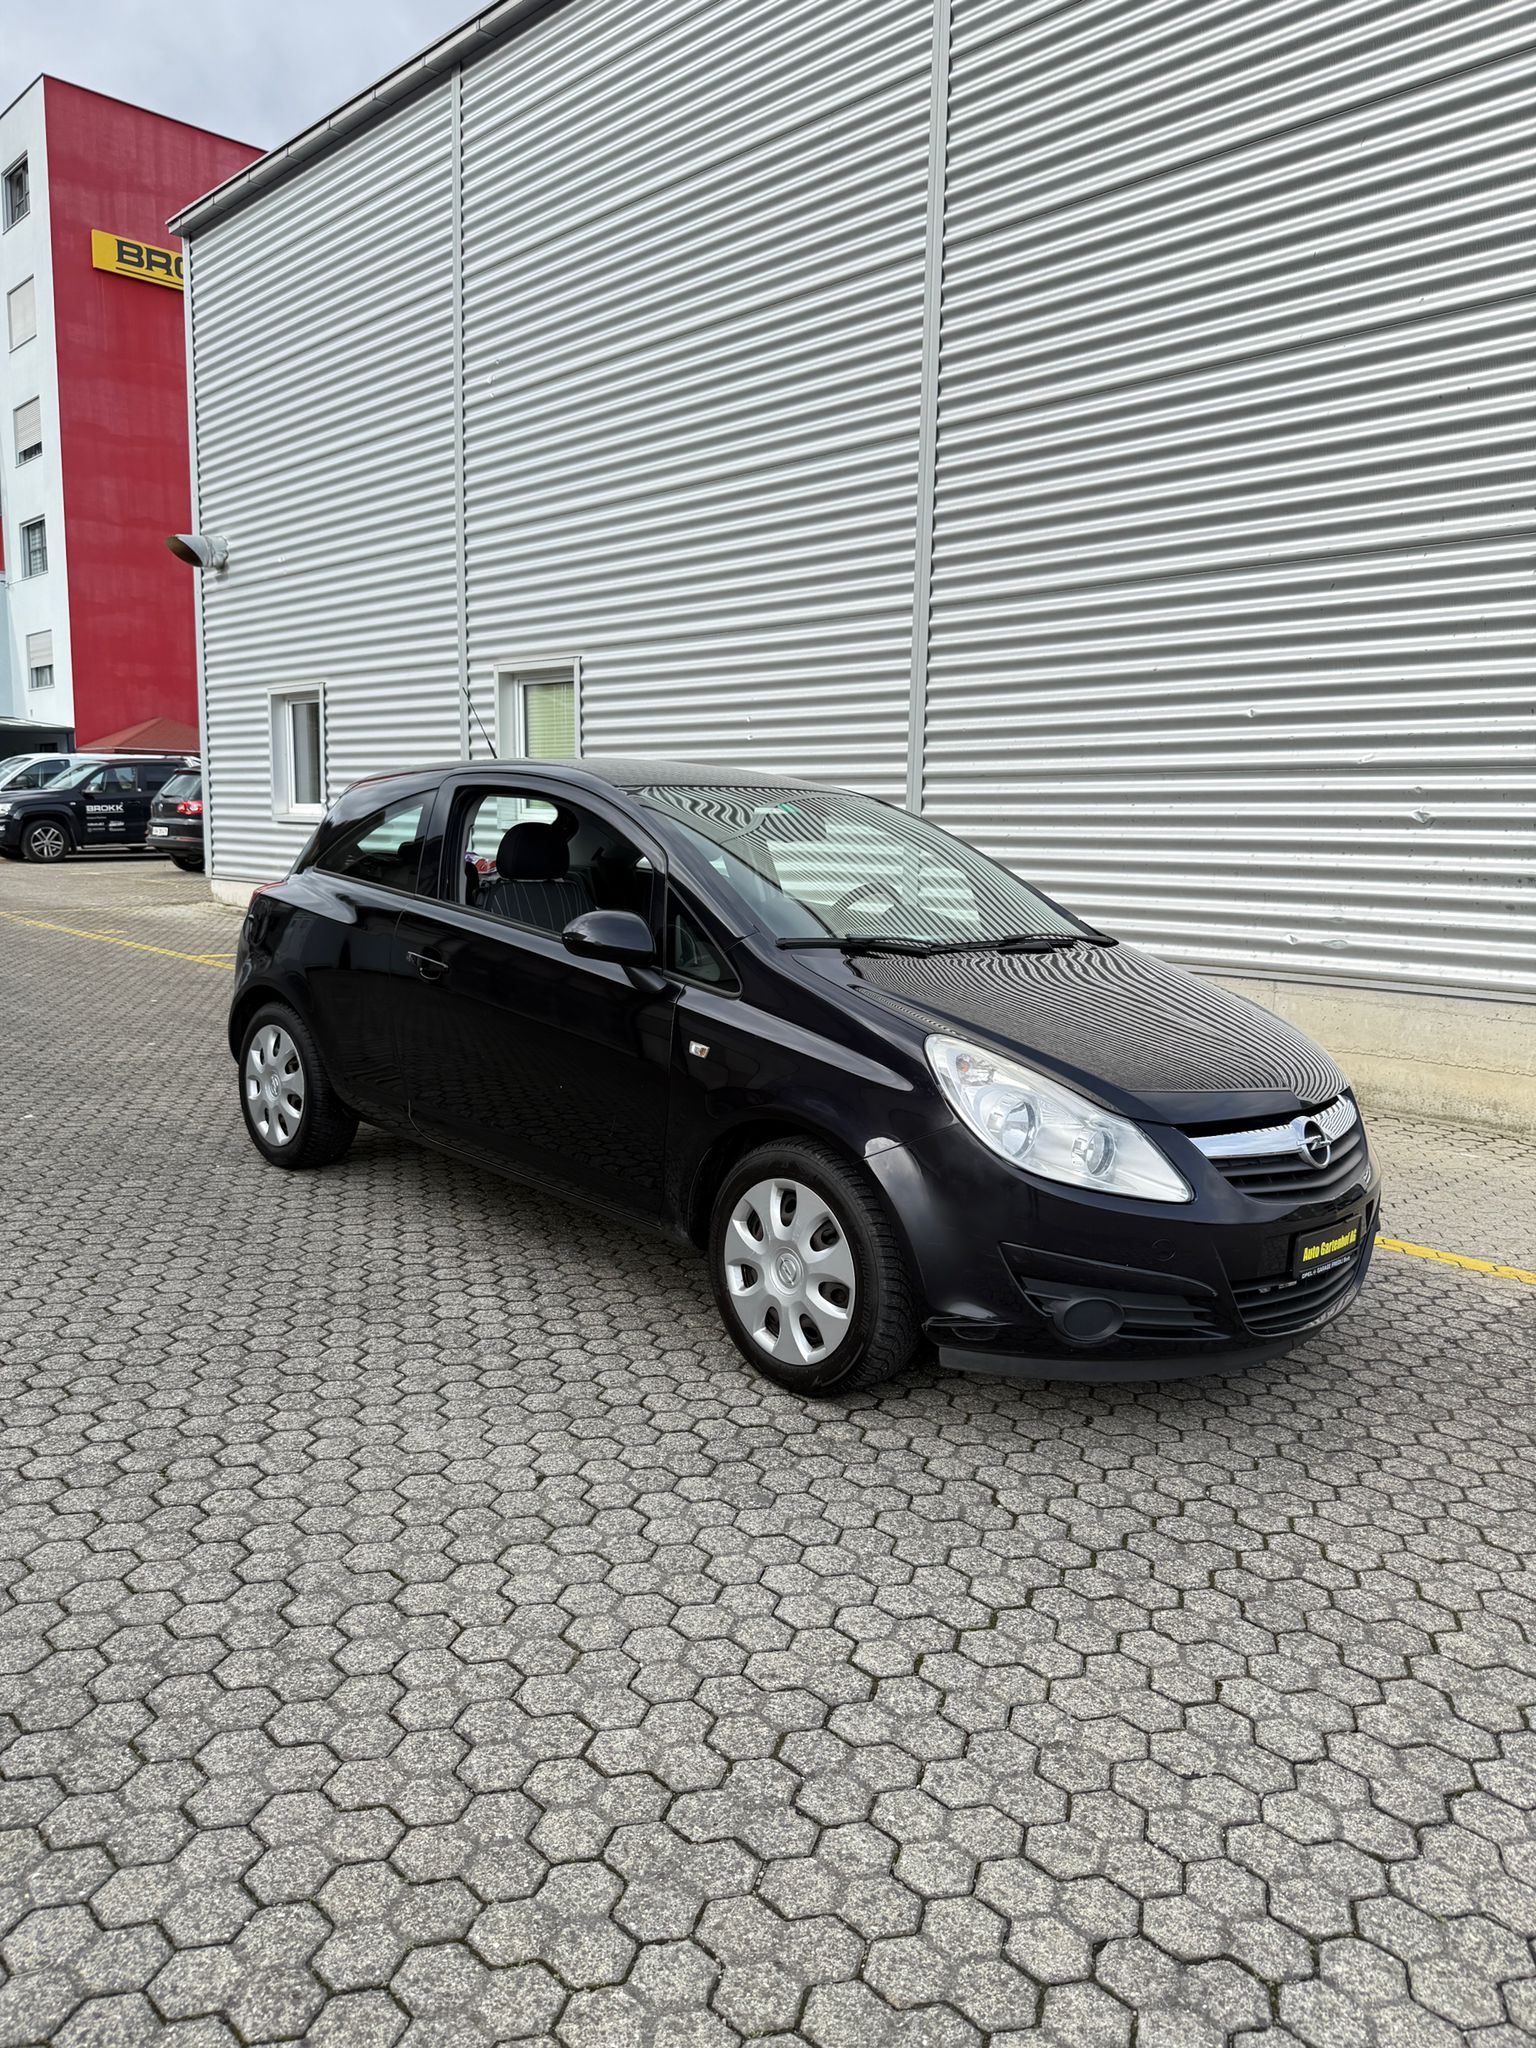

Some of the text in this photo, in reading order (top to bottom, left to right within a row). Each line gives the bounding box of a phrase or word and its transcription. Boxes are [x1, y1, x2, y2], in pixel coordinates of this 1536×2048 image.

[86, 804, 124, 812] BROKK
[1303, 1245, 1320, 1262] Auto
[1320, 1233, 1350, 1256] Gartenhof
